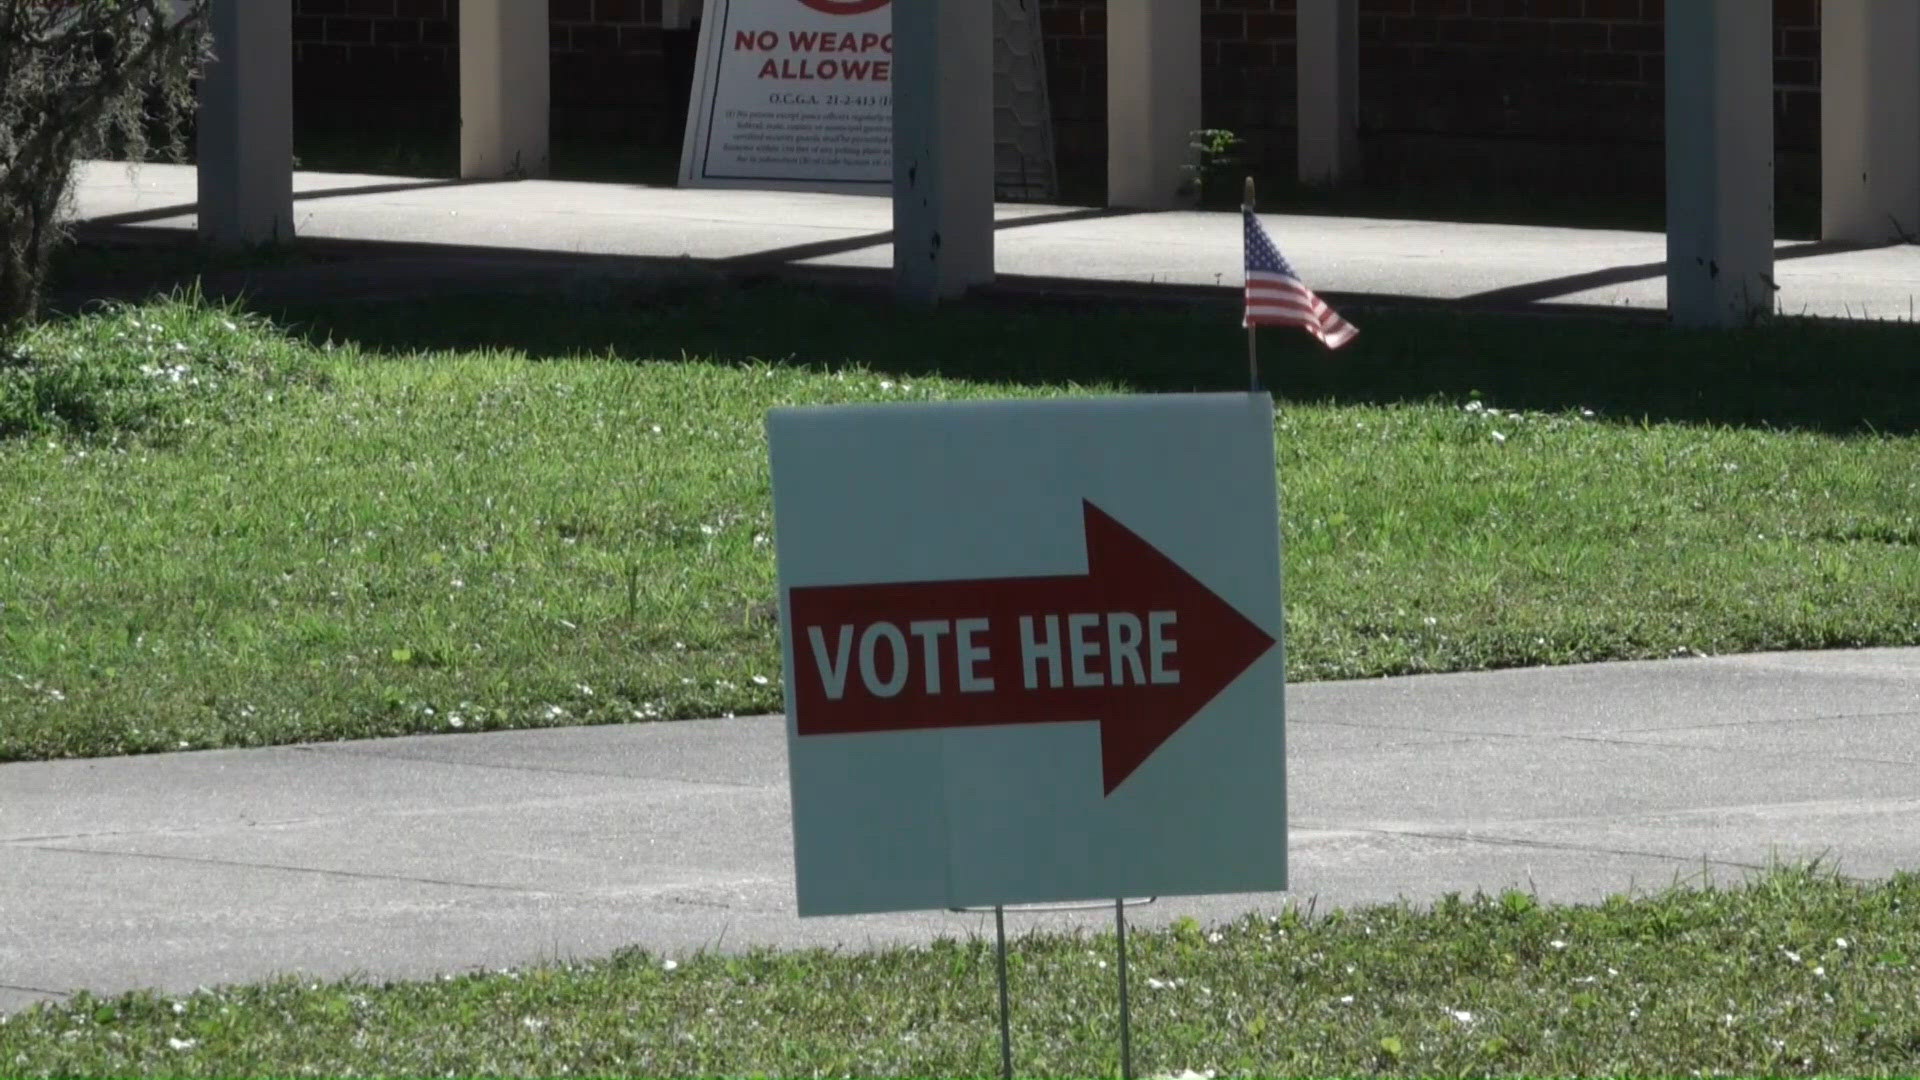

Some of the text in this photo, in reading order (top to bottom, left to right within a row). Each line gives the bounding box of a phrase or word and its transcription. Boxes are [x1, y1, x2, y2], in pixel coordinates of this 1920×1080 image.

[734, 30, 892, 53] NO WEAPO
[757, 58, 891, 81] ALLOWE
[807, 610, 1180, 700] VOTE HERE
